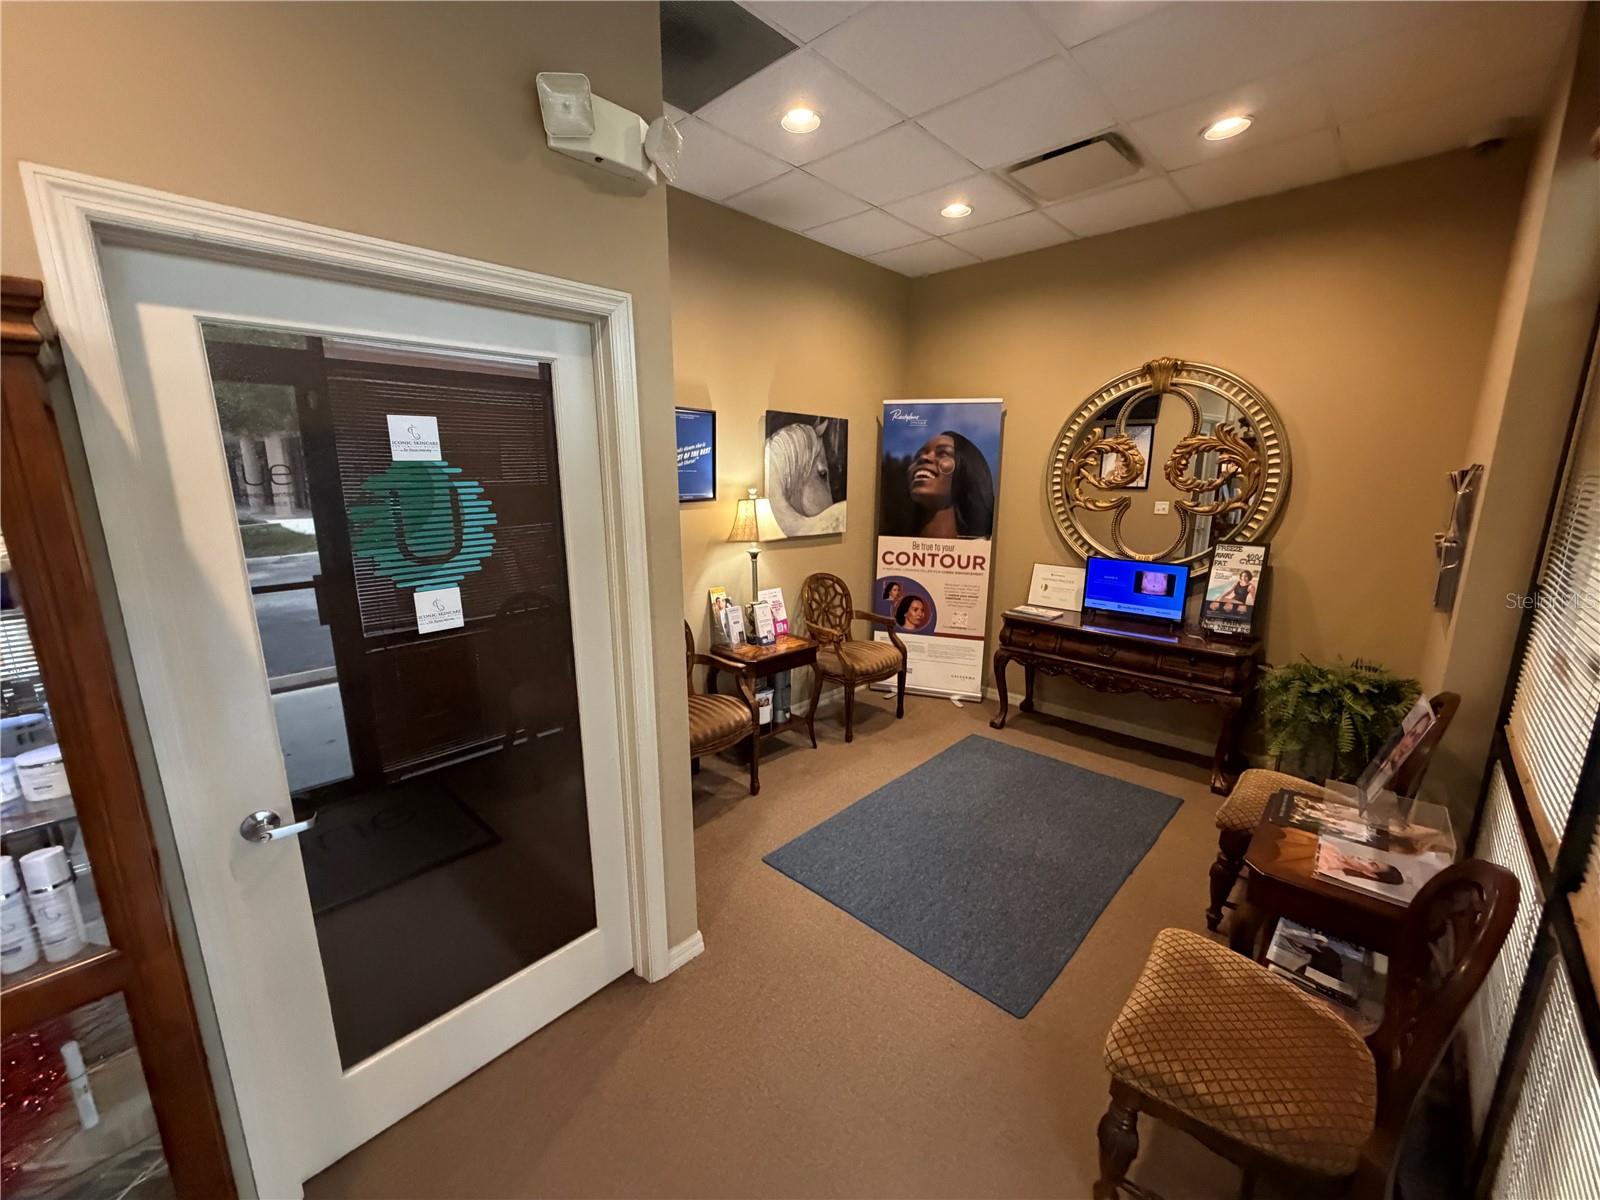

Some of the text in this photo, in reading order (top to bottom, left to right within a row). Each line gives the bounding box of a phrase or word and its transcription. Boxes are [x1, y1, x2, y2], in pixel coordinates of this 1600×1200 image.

[699, 446, 713, 455] BEST
[912, 540, 955, 553] Be true to your
[1216, 544, 1244, 552] FREEZE
[881, 550, 986, 571] CONTOUR
